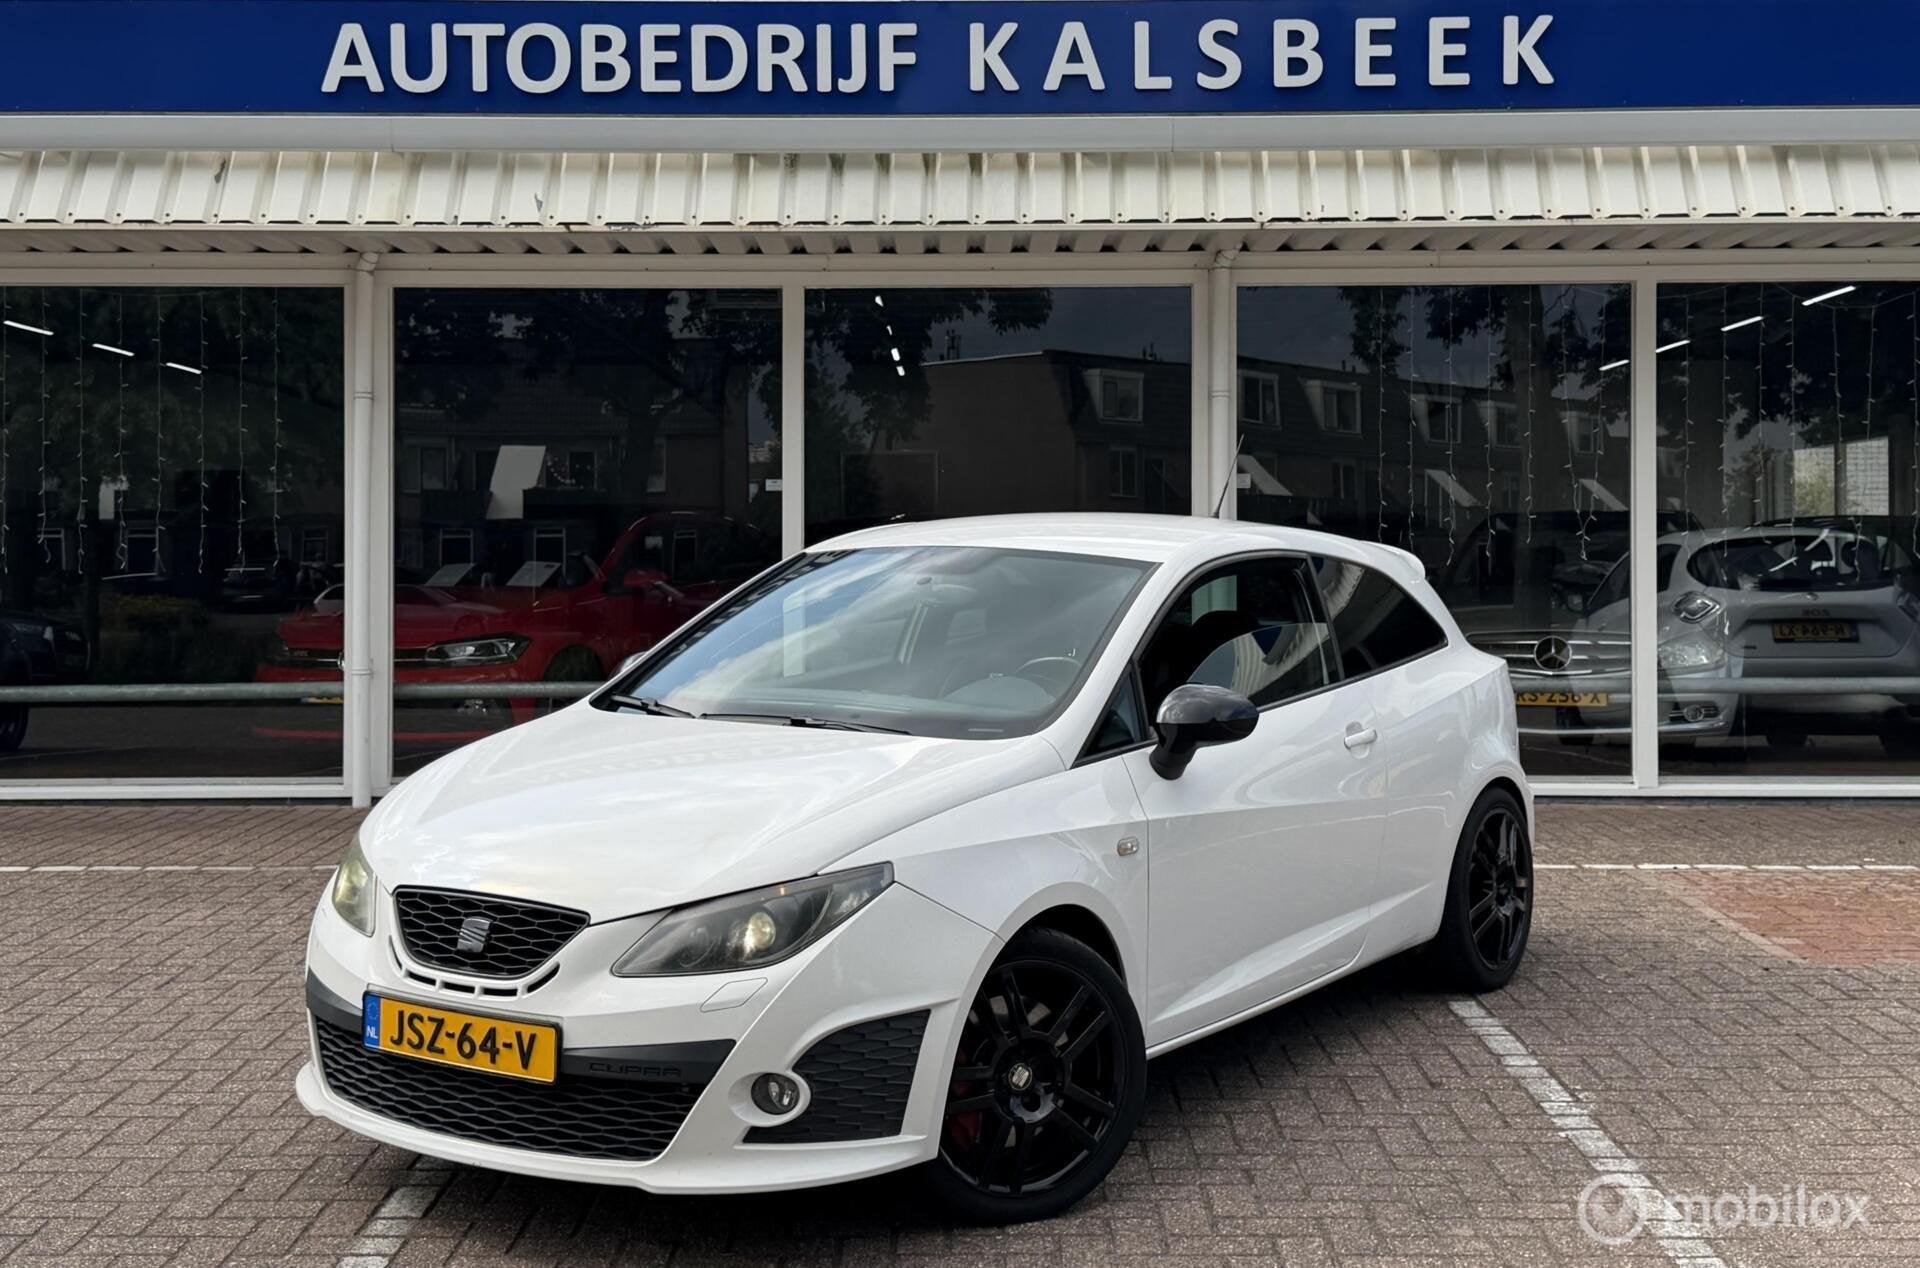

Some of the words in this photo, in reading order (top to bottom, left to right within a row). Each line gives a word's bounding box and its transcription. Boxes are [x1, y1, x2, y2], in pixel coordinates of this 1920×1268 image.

[320, 22, 918, 94] AUTOBEDRIJF
[969, 15, 1555, 92] KALSBEEK
[366, 1025, 378, 1040] NL
[389, 1009, 538, 1071] JSZ-64-V
[590, 1062, 682, 1077] CUPRA
